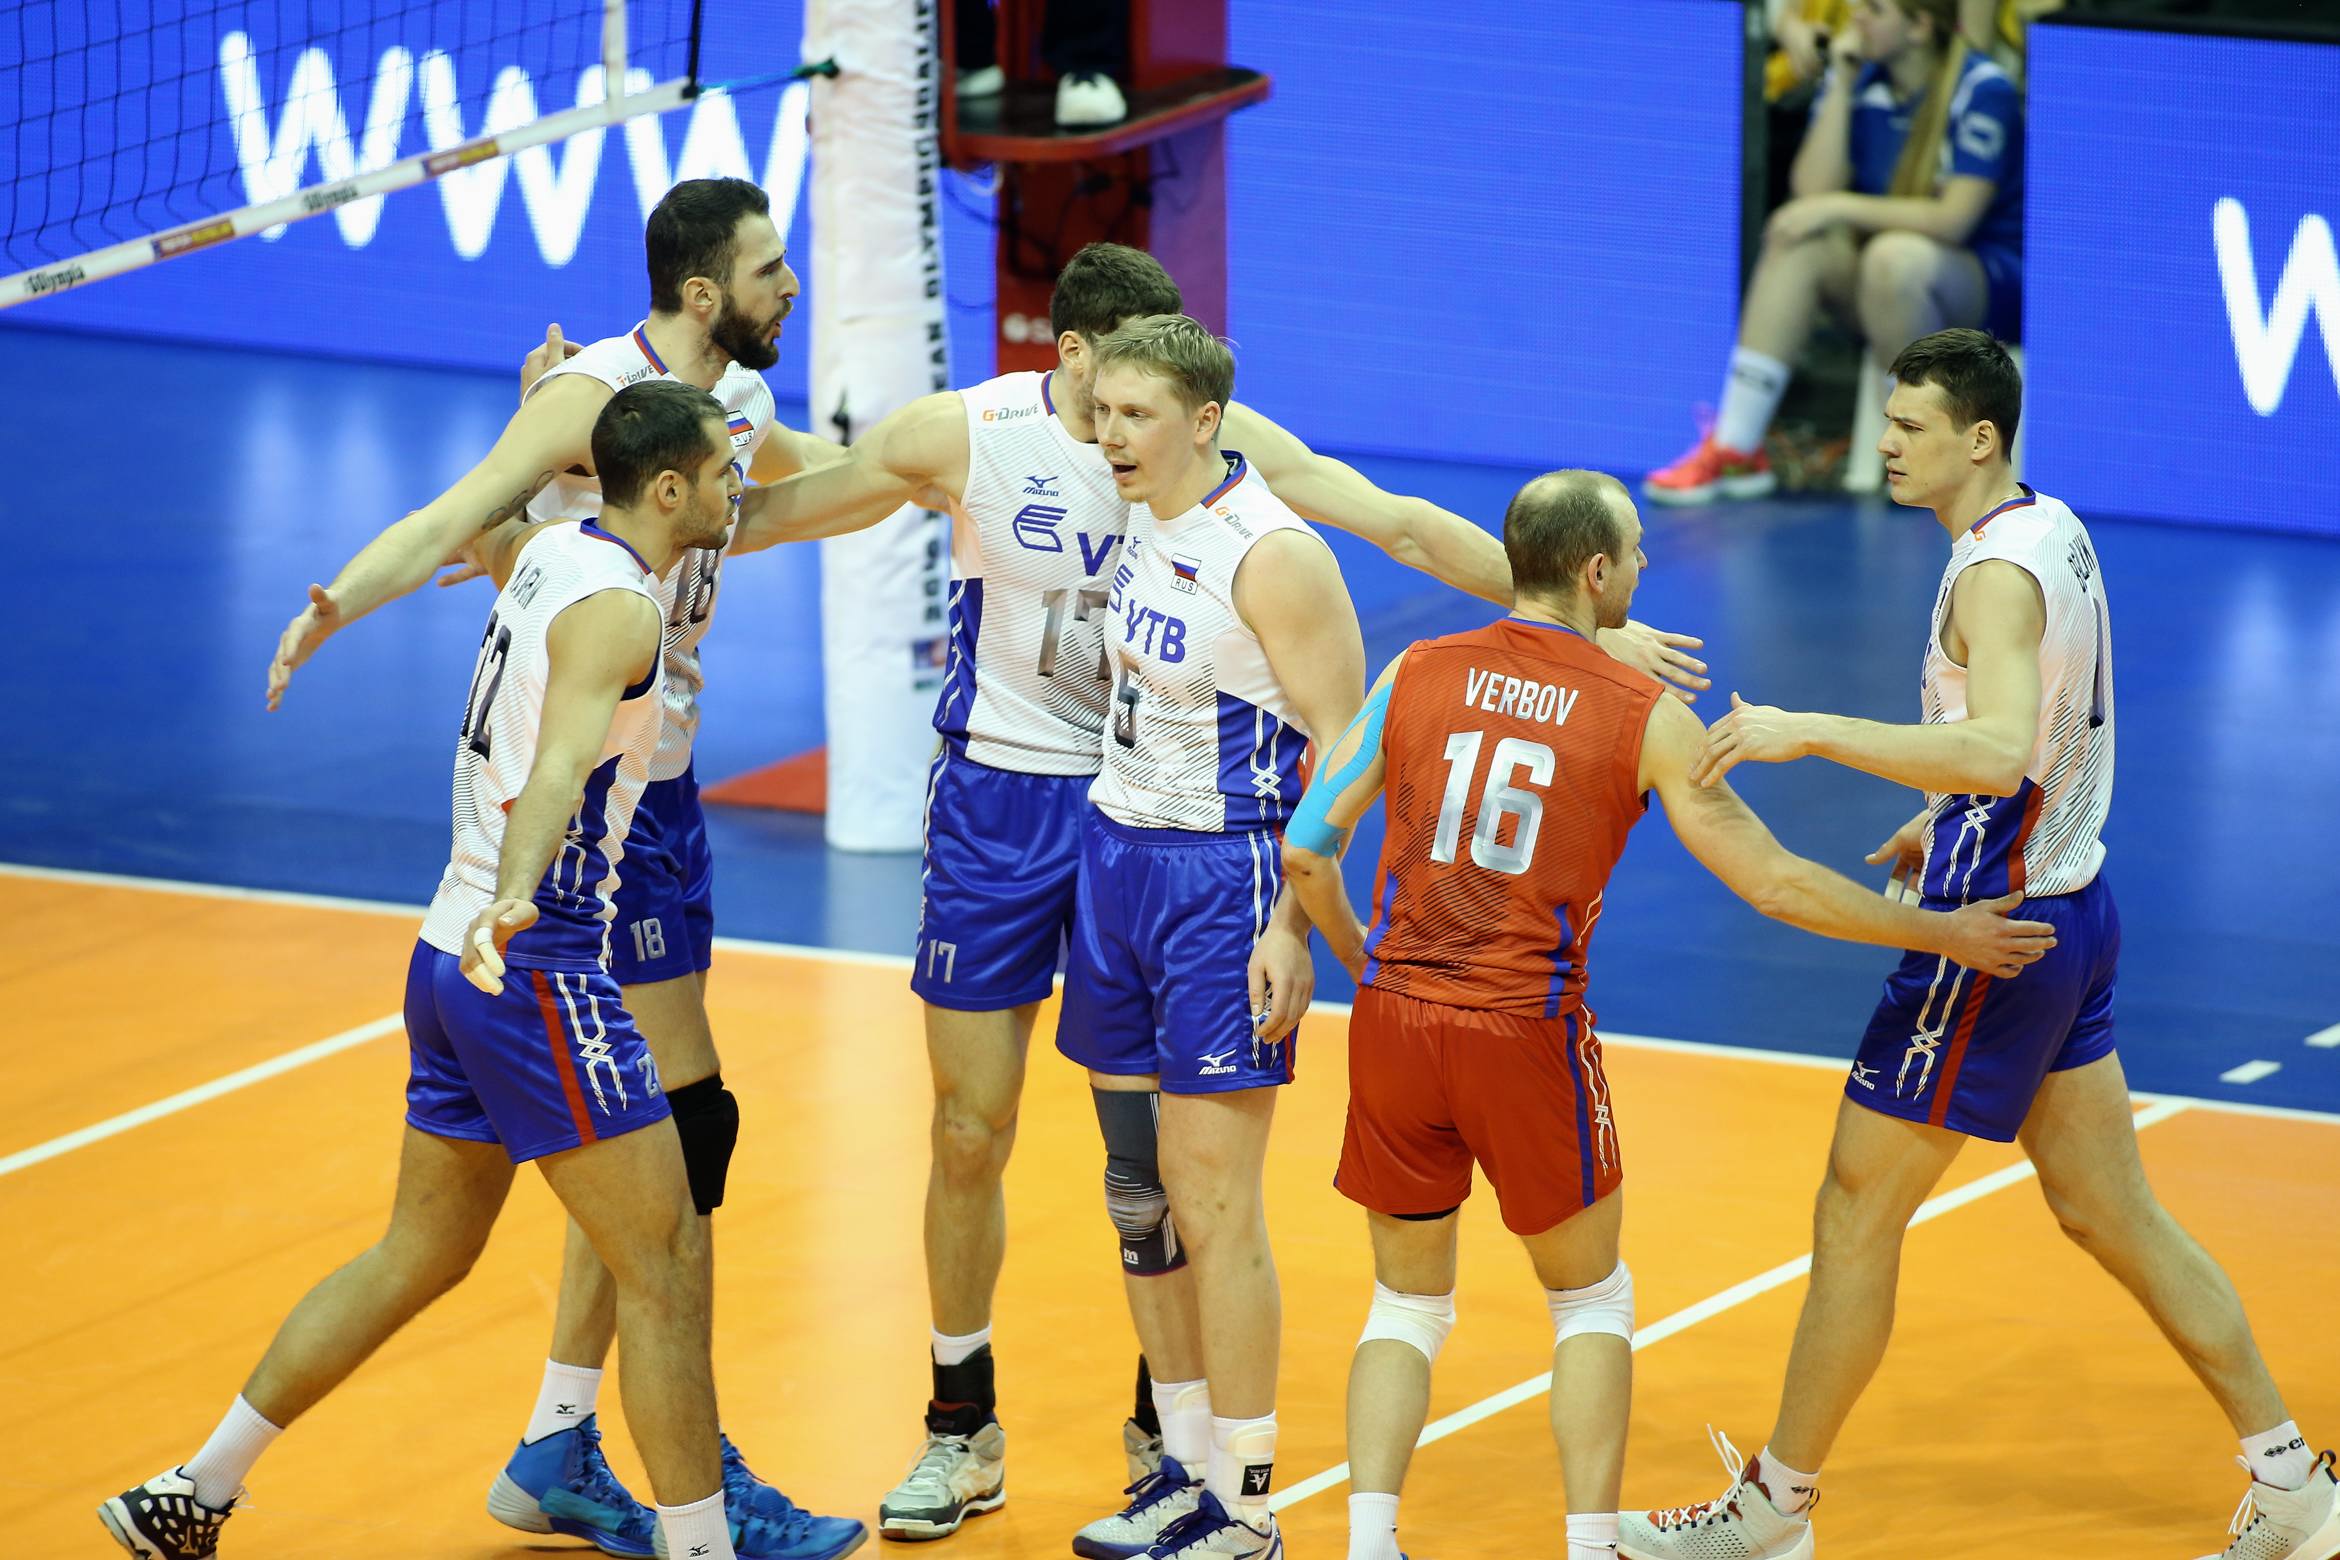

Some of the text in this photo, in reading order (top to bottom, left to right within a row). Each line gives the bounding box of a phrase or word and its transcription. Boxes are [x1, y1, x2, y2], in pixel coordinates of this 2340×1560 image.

[734, 432, 753, 443] RUS
[1175, 578, 1195, 592] RUS
[1124, 598, 1187, 664] VTB
[1463, 667, 1579, 727] VERBOV
[1430, 730, 1556, 876] 16
[630, 917, 667, 963] 18
[927, 938, 957, 984] 17
